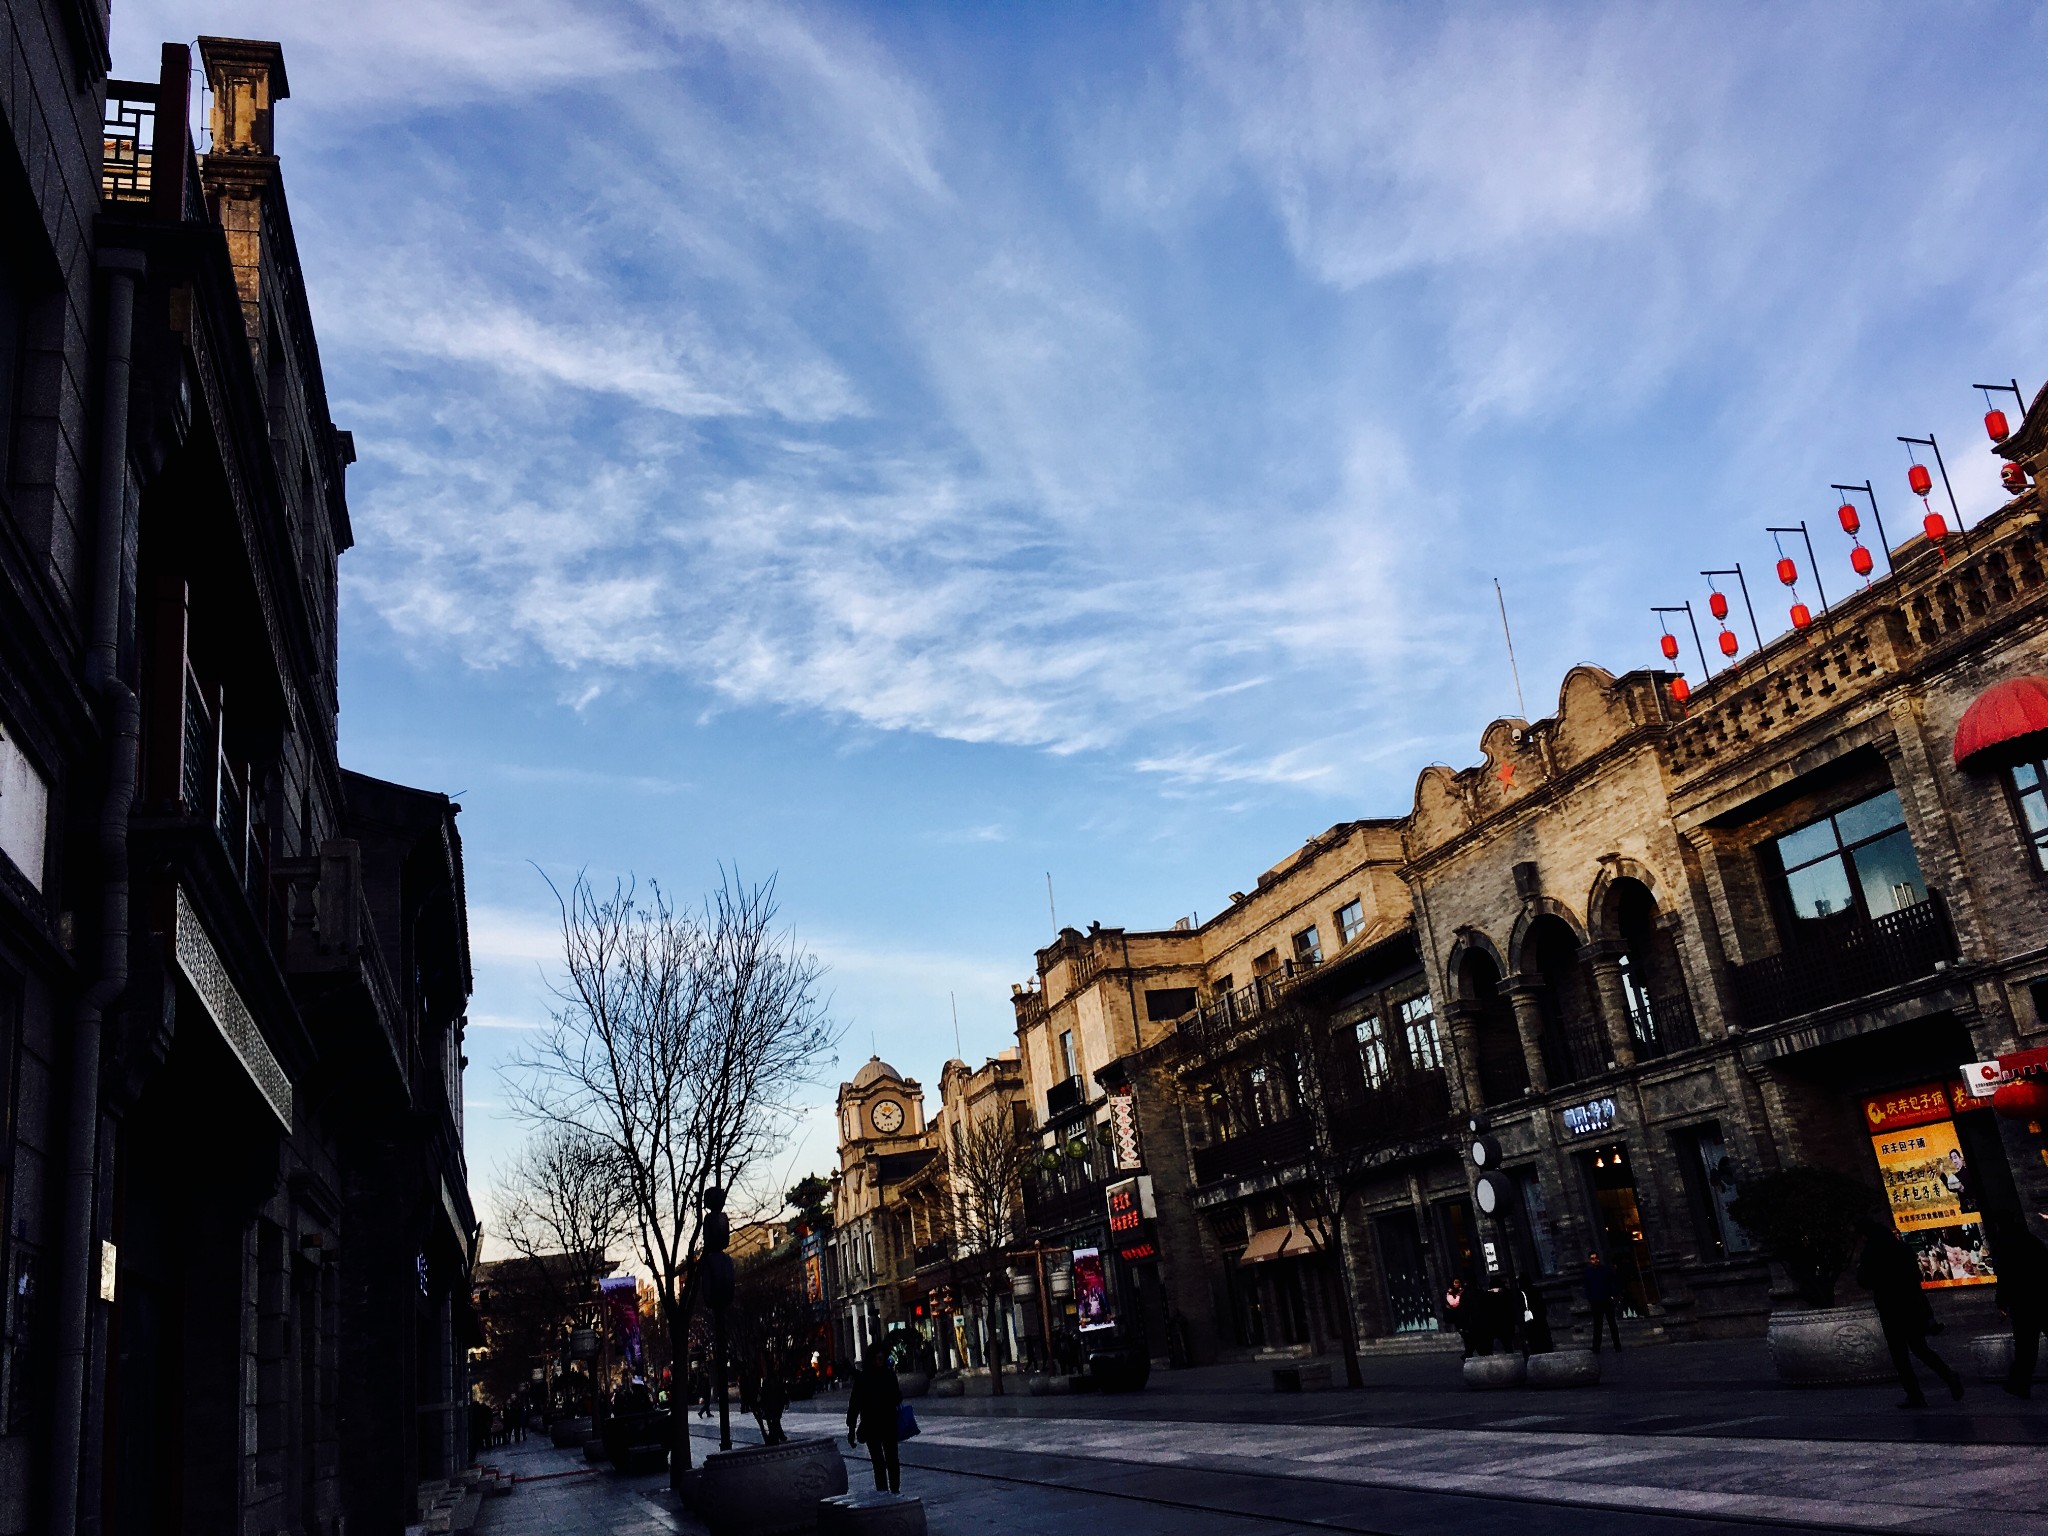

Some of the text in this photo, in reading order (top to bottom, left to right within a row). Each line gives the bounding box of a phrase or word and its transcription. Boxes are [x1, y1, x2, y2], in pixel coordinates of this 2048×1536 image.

[1886, 1091, 1945, 1114] 庆丰包子铺
[1115, 1104, 1136, 1160] 老北京小吃
